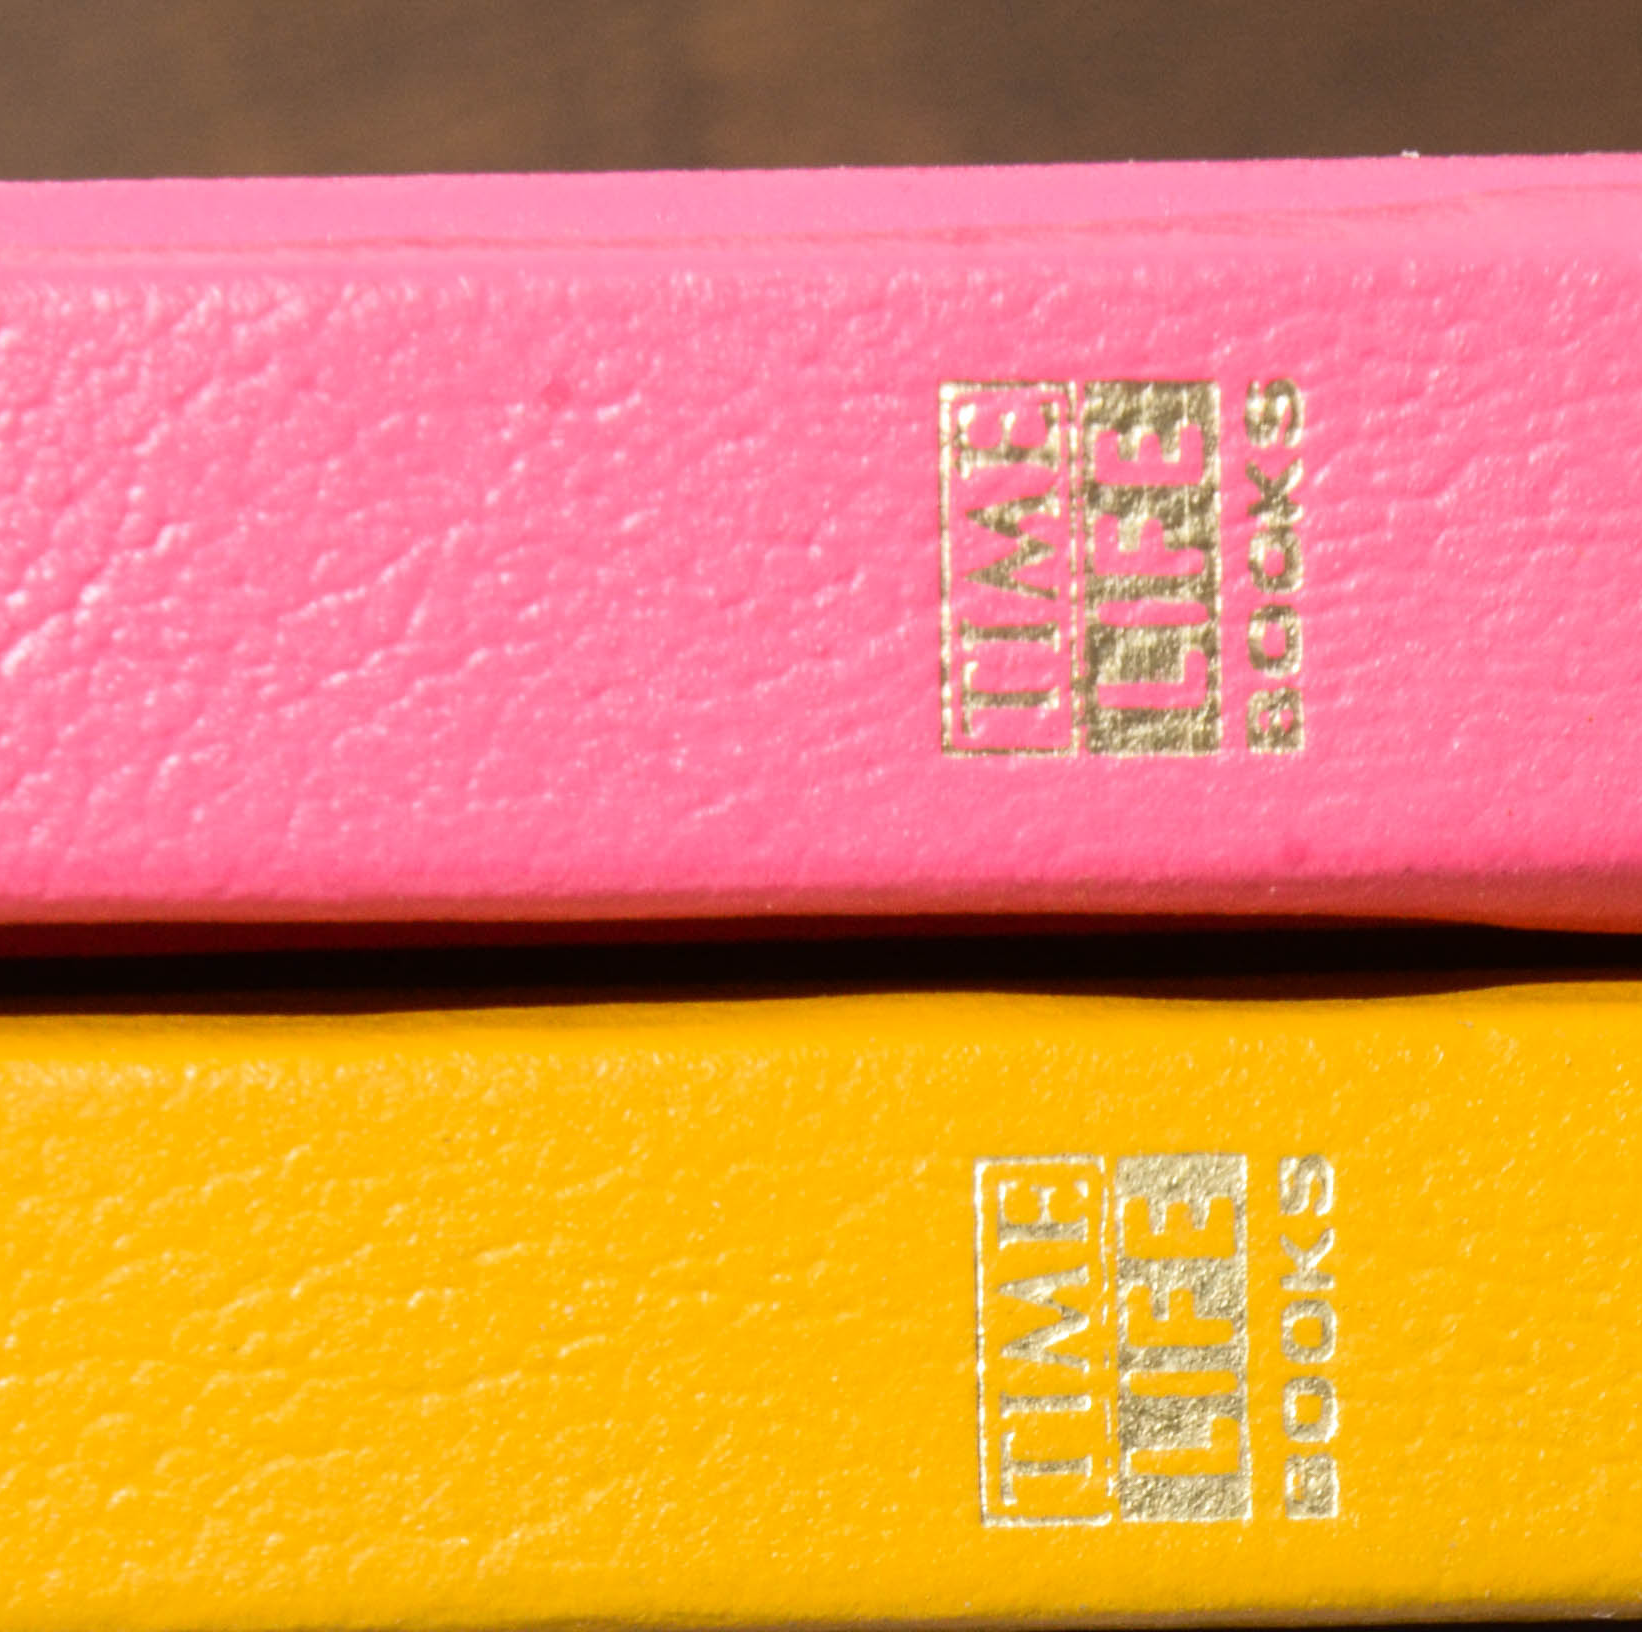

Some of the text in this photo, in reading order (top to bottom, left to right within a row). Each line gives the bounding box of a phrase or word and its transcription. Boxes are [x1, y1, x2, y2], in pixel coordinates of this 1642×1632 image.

[956, 403, 1061, 738] TIME
[1094, 423, 1208, 709] LIFE
[1245, 378, 1305, 753] BOOKS
[997, 1180, 1092, 1506] TIME
[1123, 1197, 1240, 1476] LIFE
[1279, 1154, 1339, 1519] BOOKS
